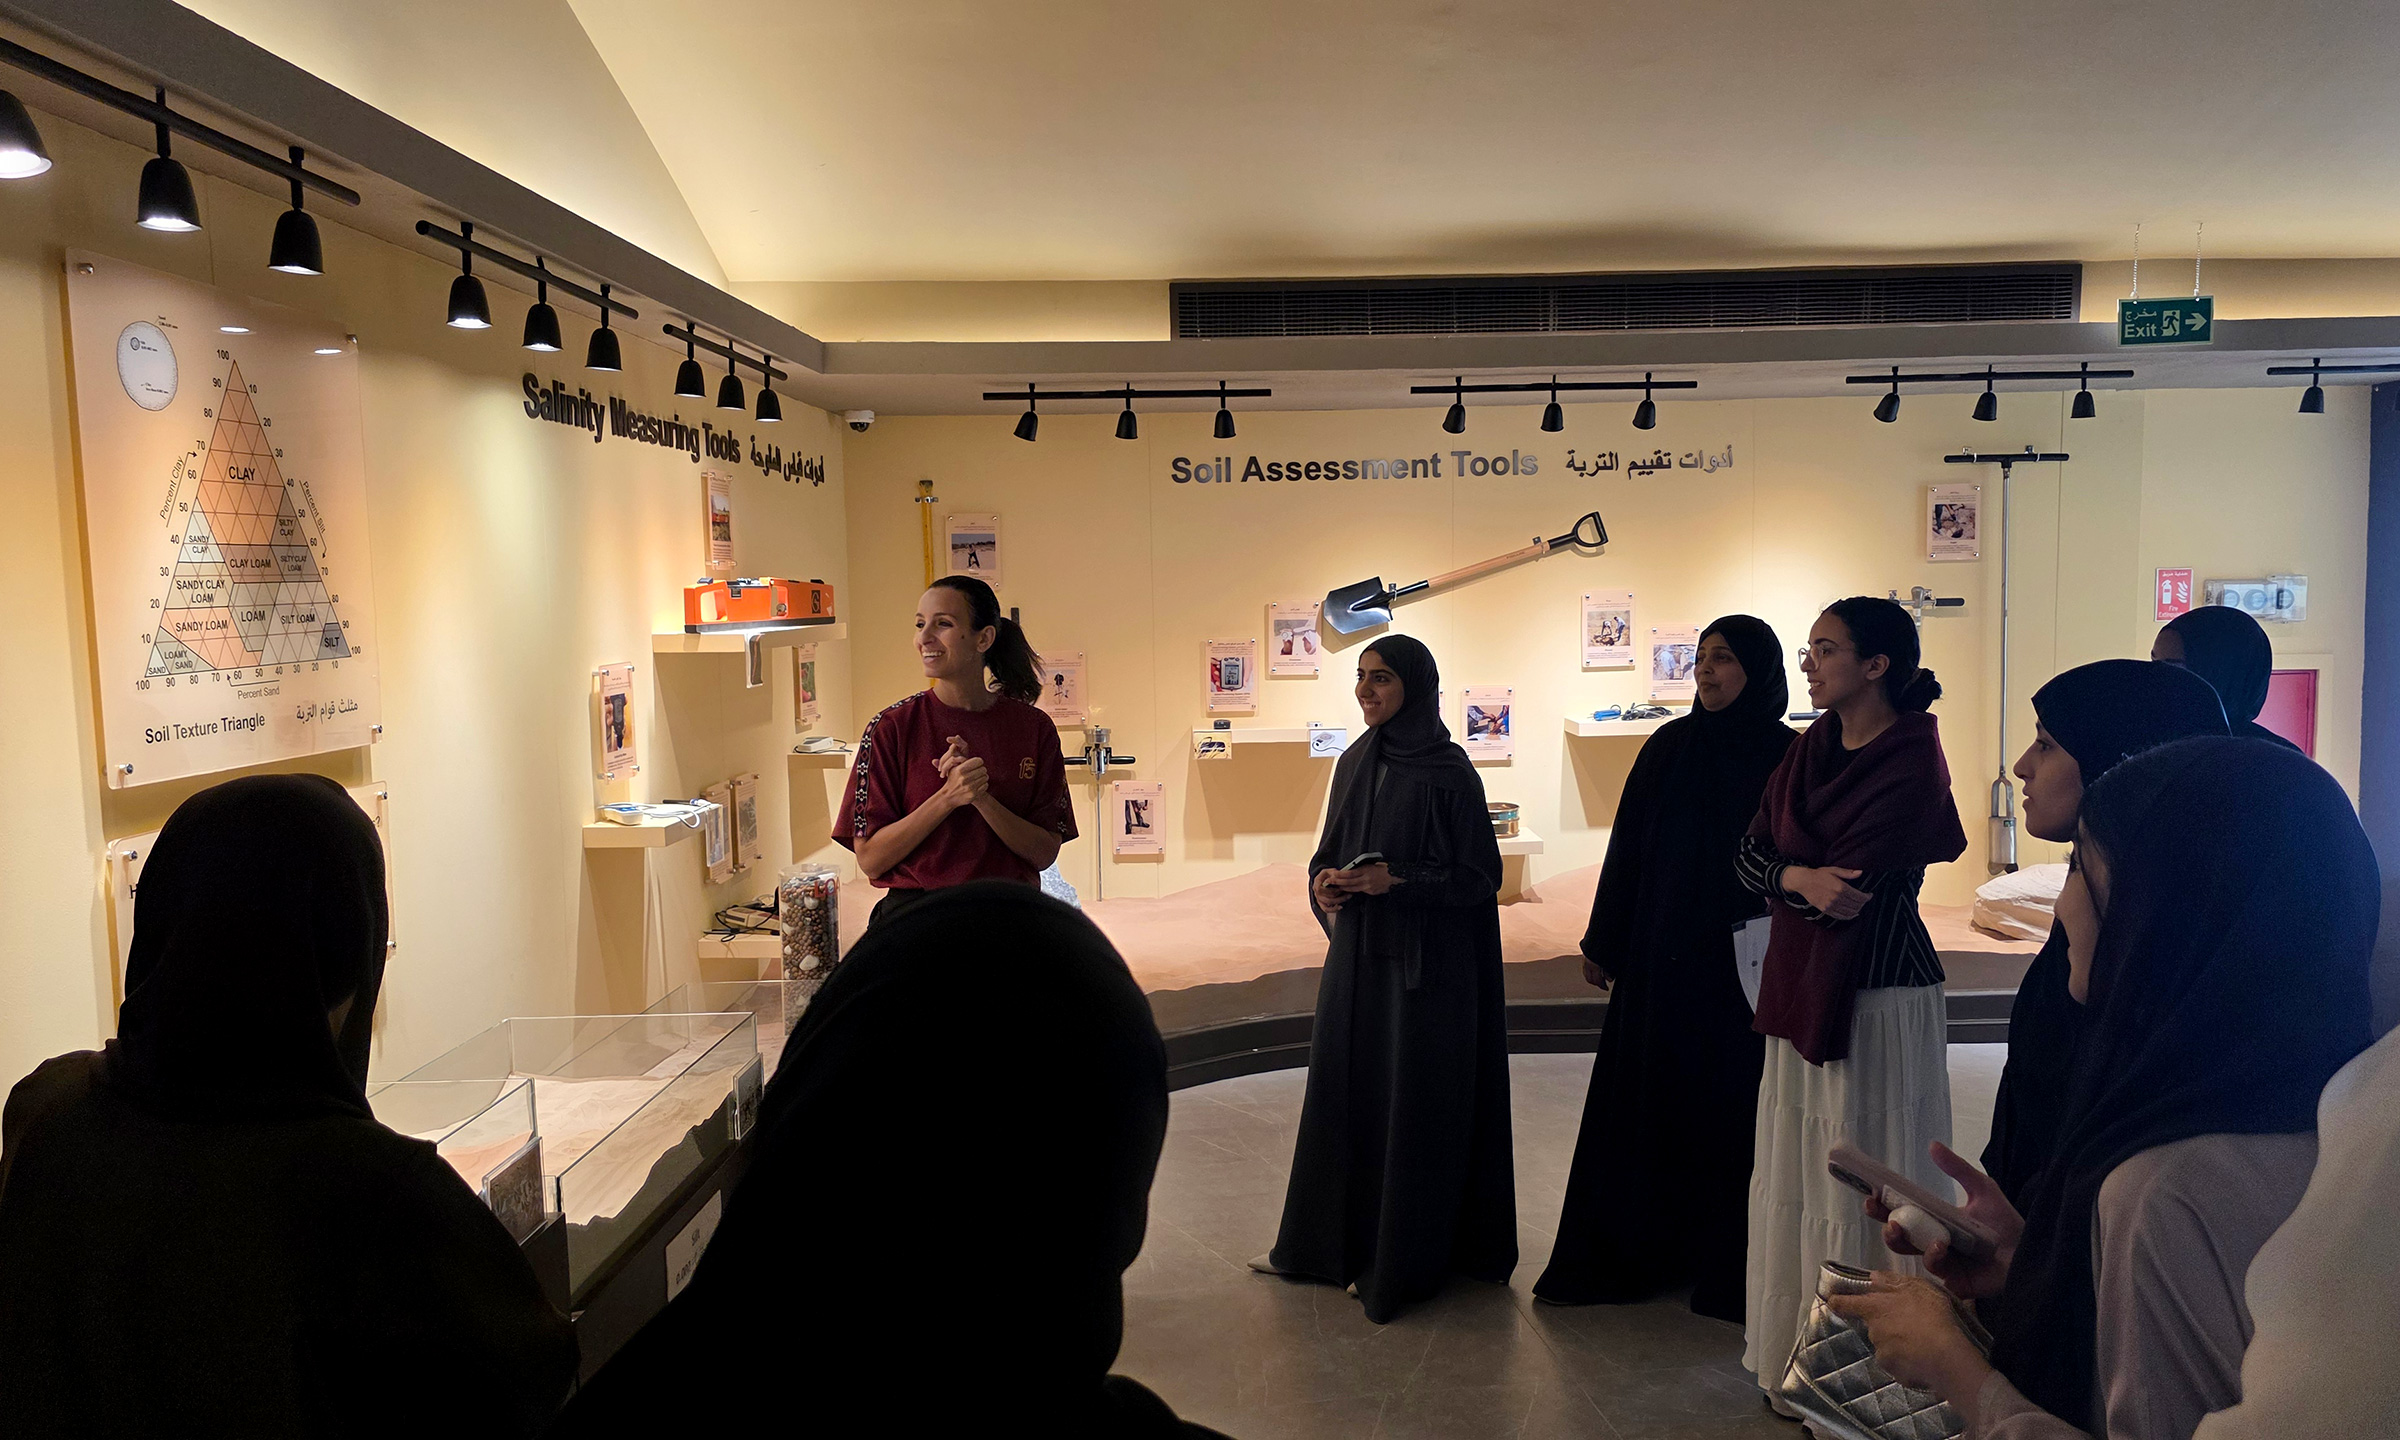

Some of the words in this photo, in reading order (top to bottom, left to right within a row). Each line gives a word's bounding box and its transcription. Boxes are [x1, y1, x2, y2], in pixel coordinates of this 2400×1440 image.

[2125, 308, 2157, 322] مخرج
[2124, 323, 2157, 338] Exit
[217, 349, 229, 360] 100
[212, 377, 222, 388] 90
[249, 384, 258, 394] 10
[203, 408, 213, 418] 80
[522, 372, 605, 443] Salinity
[609, 396, 700, 463] Measuring
[702, 422, 741, 463] Tools
[263, 417, 272, 428] 20
[196, 440, 206, 450] 70
[275, 448, 284, 458] 30
[1565, 449, 1619, 478] التربة
[1678, 444, 1734, 474] أدوات
[1171, 456, 1231, 484] Soil
[1241, 452, 1441, 482] Assessment
[1450, 449, 1539, 477] Tools
[1627, 449, 1672, 480] تقييم
[187, 469, 197, 480] 60
[229, 466, 256, 481] CLAY
[287, 478, 295, 487] 40
[179, 502, 189, 512] 50
[298, 508, 306, 518] 50
[280, 528, 294, 536] CLAY
[170, 534, 180, 544] 40
[188, 535, 210, 543] SANDY
[310, 538, 318, 547] 60
[192, 546, 209, 554] CLAY
[229, 559, 249, 568] CLAY
[250, 559, 272, 568] LOAM
[160, 567, 170, 577] 30
[321, 567, 329, 576] 70
[176, 580, 204, 590] SANDY
[206, 580, 225, 590] CLAY
[150, 598, 160, 609] 20
[191, 594, 214, 603] LOAM
[331, 594, 339, 603] 80
[241, 610, 266, 622] LOAM
[281, 614, 295, 625] SILT
[297, 613, 316, 624] LOAM
[175, 620, 204, 632] SANDY
[205, 620, 228, 631] LOAM
[342, 620, 350, 629] 90
[141, 633, 151, 644] 10
[324, 637, 340, 648] SILT
[164, 650, 188, 660] LOAMY
[351, 645, 361, 655] 100
[175, 660, 193, 670] SAND
[293, 664, 301, 674] 30
[311, 662, 319, 672] 20
[332, 660, 339, 669] 10
[148, 666, 167, 675] SAND
[233, 670, 243, 680] 60
[255, 668, 264, 678] 50
[275, 666, 283, 675] 40
[189, 674, 199, 685] 80
[211, 672, 221, 682] 70
[136, 680, 150, 691] 100
[165, 677, 176, 688] 90
[237, 690, 263, 700] Percent
[263, 686, 280, 697] Sand
[338, 698, 358, 714] مثلث
[296, 704, 317, 724] التربة
[320, 700, 336, 724] قوام
[145, 726, 170, 744] Soil
[173, 722, 218, 740] Texture
[221, 713, 266, 732] Triangle
